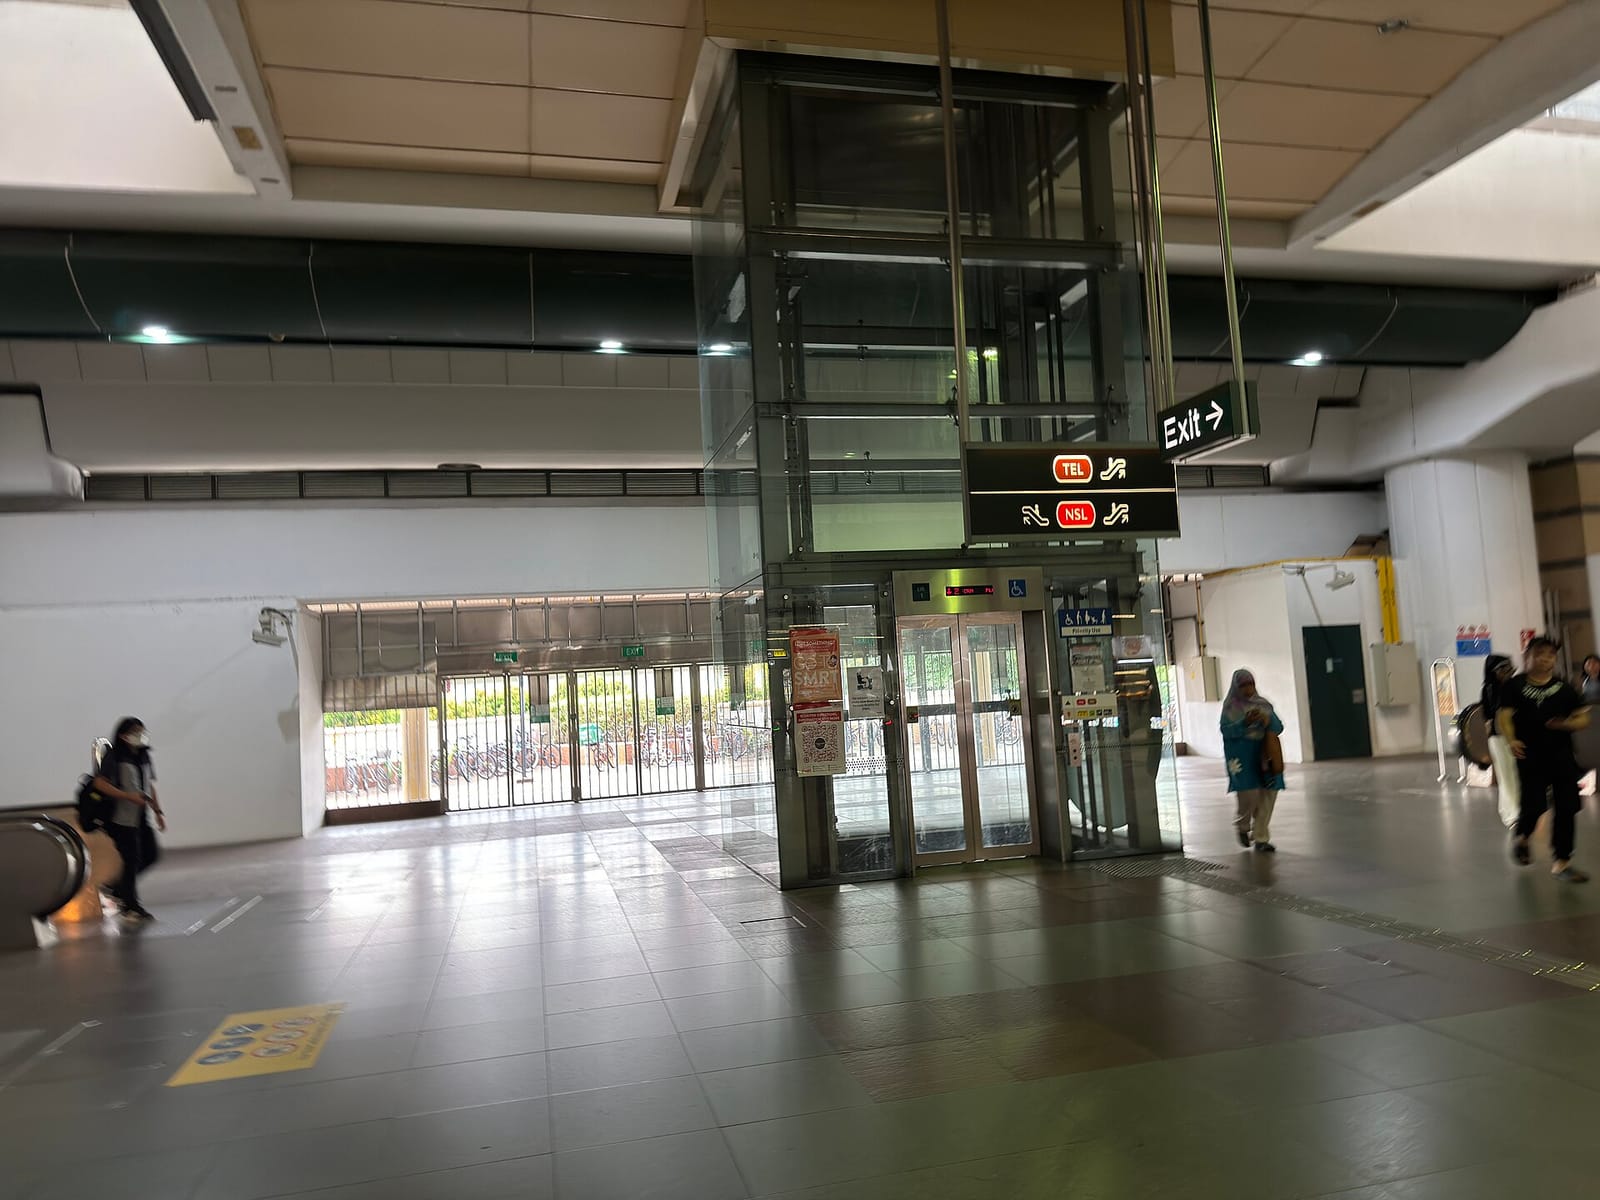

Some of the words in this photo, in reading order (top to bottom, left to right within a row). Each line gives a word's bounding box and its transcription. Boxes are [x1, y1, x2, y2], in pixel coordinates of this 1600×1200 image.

[1164, 407, 1201, 450] Exit
[1062, 462, 1084, 476] TEL
[1065, 507, 1088, 521] NSL
[626, 646, 640, 655] EXIT
[795, 671, 838, 686] SMRT
